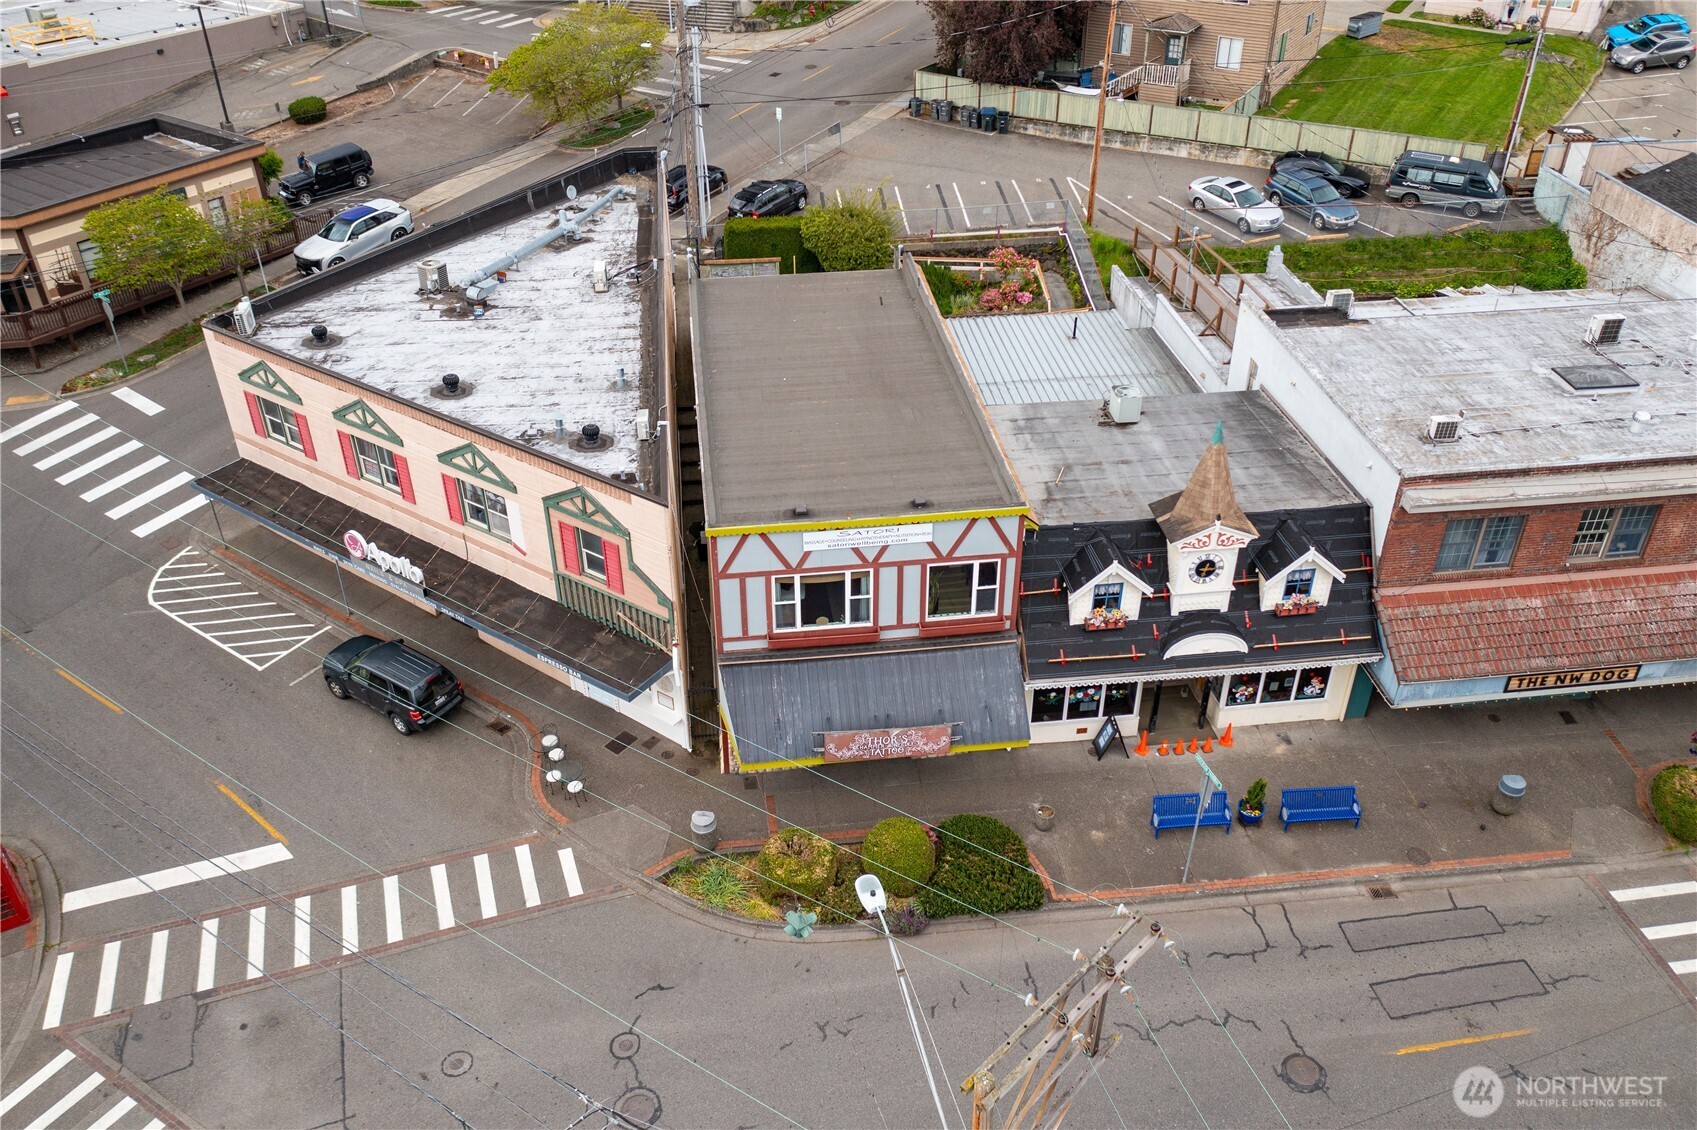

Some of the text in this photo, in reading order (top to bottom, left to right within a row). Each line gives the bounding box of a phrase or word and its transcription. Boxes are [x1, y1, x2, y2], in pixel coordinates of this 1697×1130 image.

[837, 527, 900, 537] SATORI
[828, 538, 908, 548] satoriwellbeing.com
[367, 541, 425, 584] Apollo
[536, 653, 582, 679] ESPRESSO BAR
[1516, 669, 1630, 689] THE NW DOG
[867, 734, 908, 745] THOR'S
[870, 747, 905, 758] TATTOO
